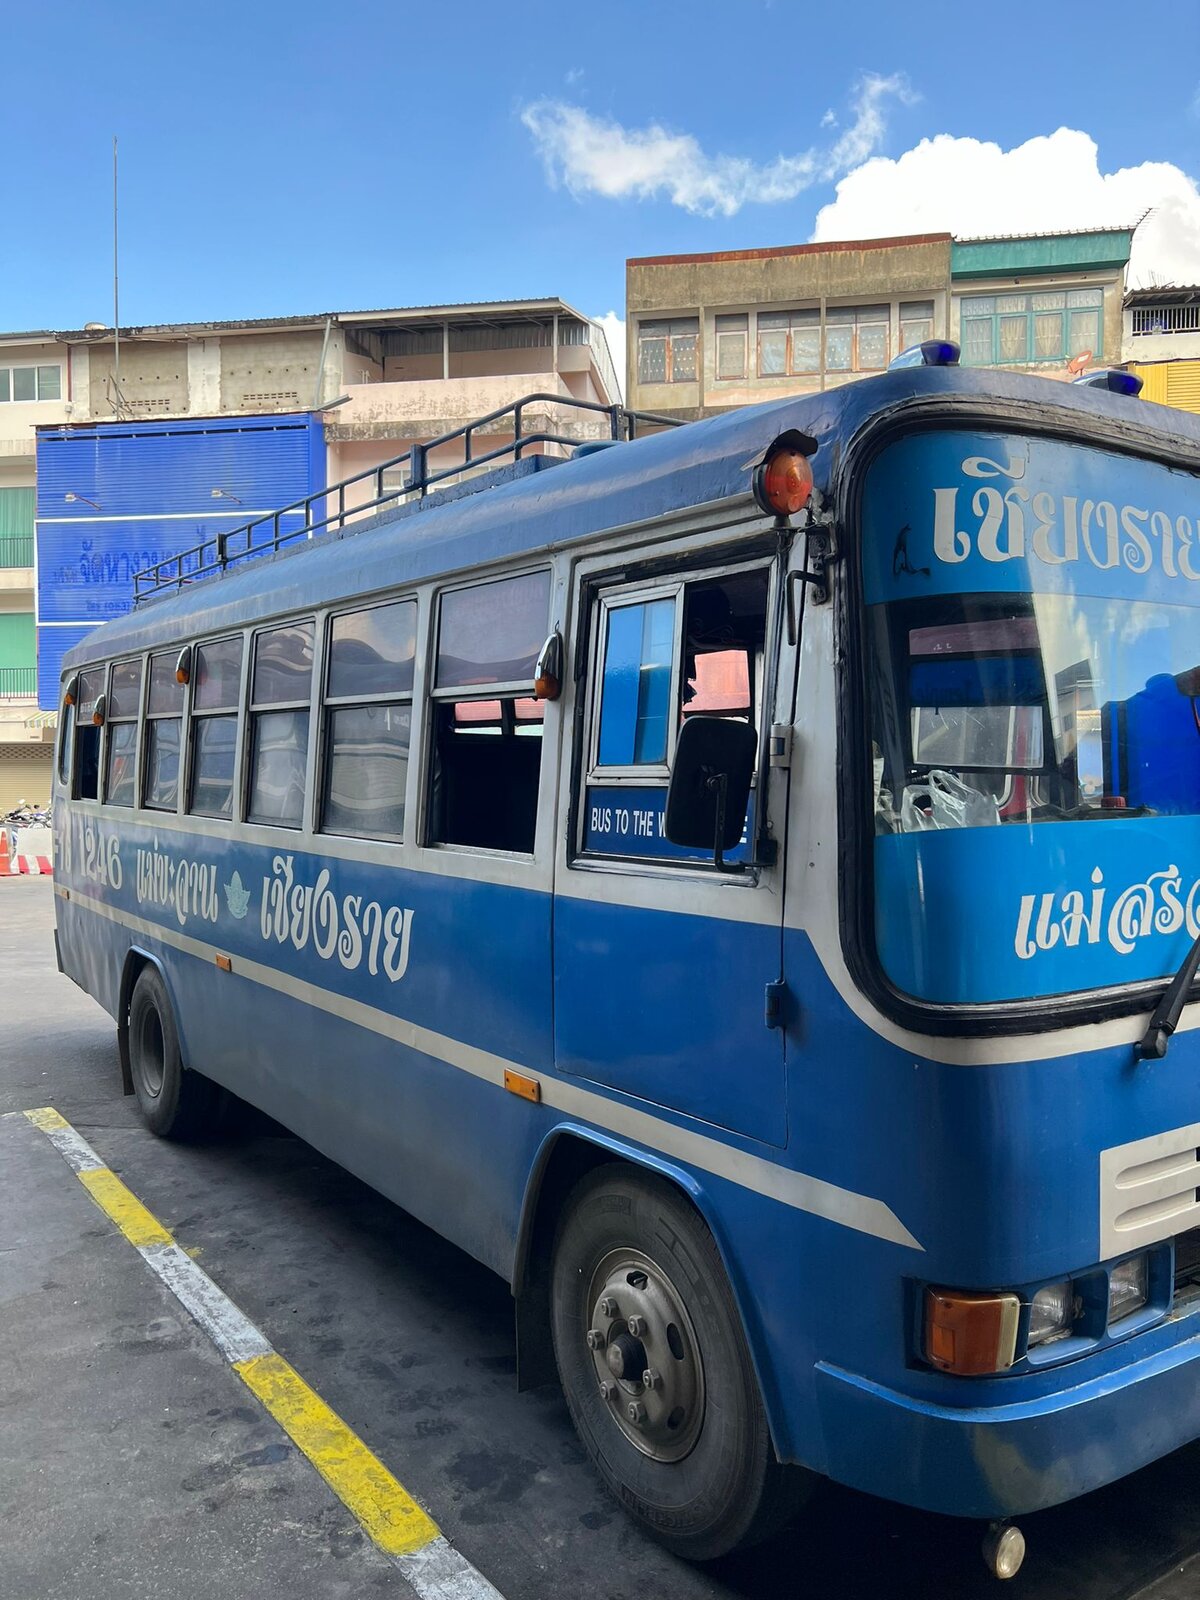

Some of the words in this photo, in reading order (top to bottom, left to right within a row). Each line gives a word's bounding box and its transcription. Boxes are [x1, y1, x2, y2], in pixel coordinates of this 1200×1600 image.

[933, 456, 1200, 581] เชียงราย
[591, 807, 612, 833] BUS
[615, 808, 628, 835] TO
[633, 810, 653, 837] THE
[79, 824, 122, 890] 1246
[260, 855, 414, 982] เชียงราย
